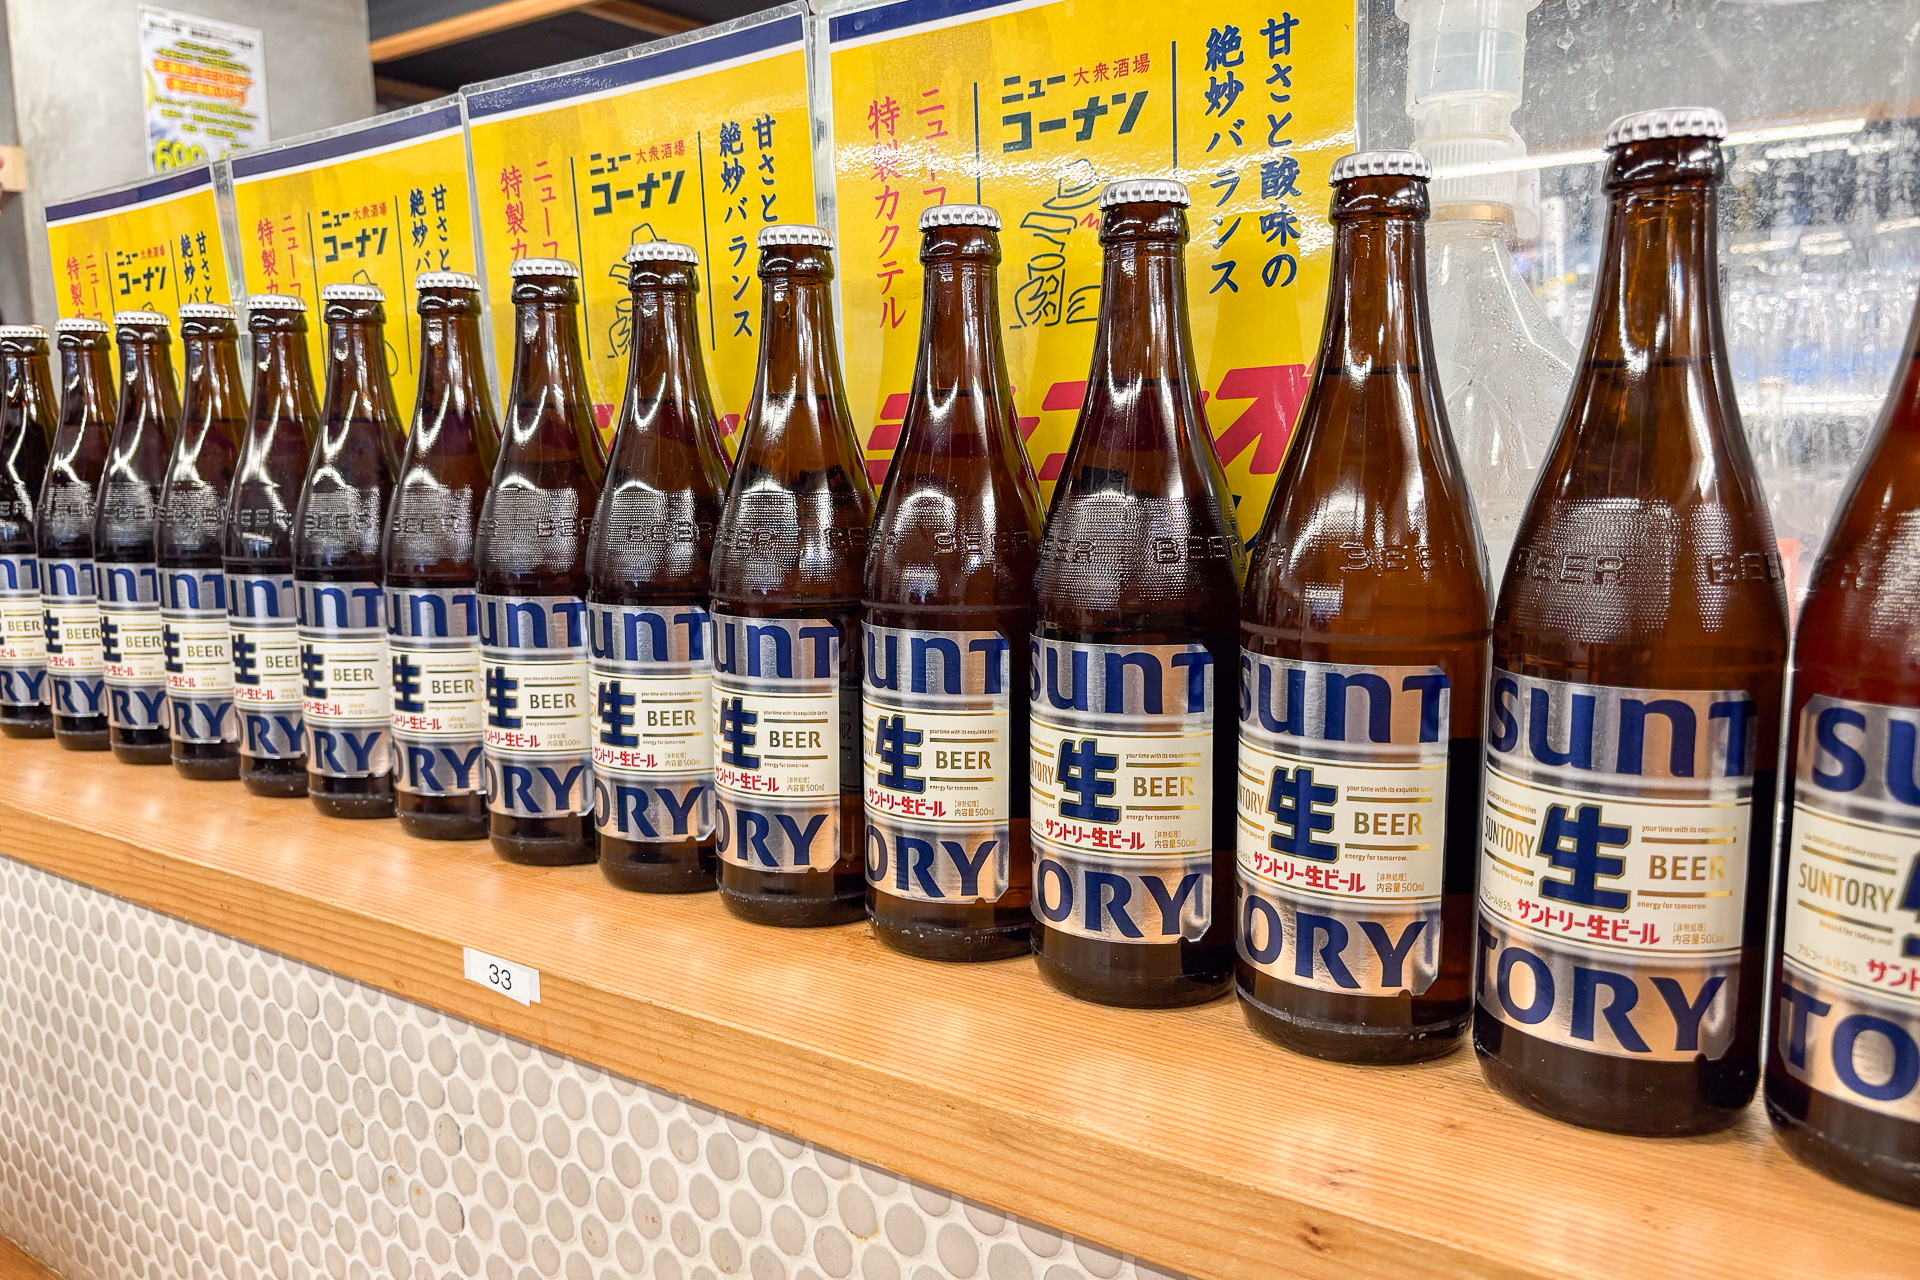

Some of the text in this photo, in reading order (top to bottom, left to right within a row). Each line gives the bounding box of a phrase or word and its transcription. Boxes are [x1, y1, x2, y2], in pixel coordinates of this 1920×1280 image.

[1073, 52, 1151, 87] 大衆酒場
[1001, 74, 1066, 104] ニュー
[1002, 91, 1148, 153] コーナン
[590, 152, 632, 176] ニュー
[635, 139, 686, 165] 大衆酒場
[1203, 24, 1244, 296] 絶妙バランス
[1260, 12, 1300, 289] 甘さと酸味の
[752, 114, 779, 222] 甘さと
[590, 170, 686, 216] コーナン
[321, 211, 351, 229] ニュー
[718, 121, 752, 338] 絶妙バランス
[116, 252, 139, 267] ニュー
[323, 226, 389, 263] コーナン
[118, 266, 167, 295] コーナン
[187, 645, 224, 658] BEER
[333, 668, 374, 682] BEER
[392, 654, 425, 714] 生
[432, 679, 475, 694] BEER
[486, 666, 523, 730] 生
[530, 693, 577, 709] BEER
[597, 680, 639, 749] 生
[647, 710, 697, 726] BEER
[720, 696, 761, 771] 生
[769, 731, 821, 748] BEER
[875, 713, 927, 795] 生
[936, 751, 991, 769] BEER
[715, 765, 780, 793] サントリー生ビール
[1055, 737, 1121, 825] 生
[1134, 776, 1194, 797] BEER
[869, 788, 947, 818] サントリー生ビール
[1265, 765, 1340, 864] 生
[1046, 819, 1145, 850] サントリー生ビール
[1354, 811, 1423, 836] BEER
[1485, 815, 1535, 858] SUNTORY
[865, 824, 998, 898] ORY
[1535, 802, 1632, 914] 生
[1836, 842, 1850, 852] draft
[1254, 851, 1366, 894] サントリー生ビール
[1649, 855, 1725, 880] BEER
[1524, 879, 1533, 887] and
[1798, 862, 1894, 914] SUNTORY
[1518, 898, 1661, 946] サントリー生ビール
[1843, 925, 1853, 936] for
[489, 964, 512, 990] 33
